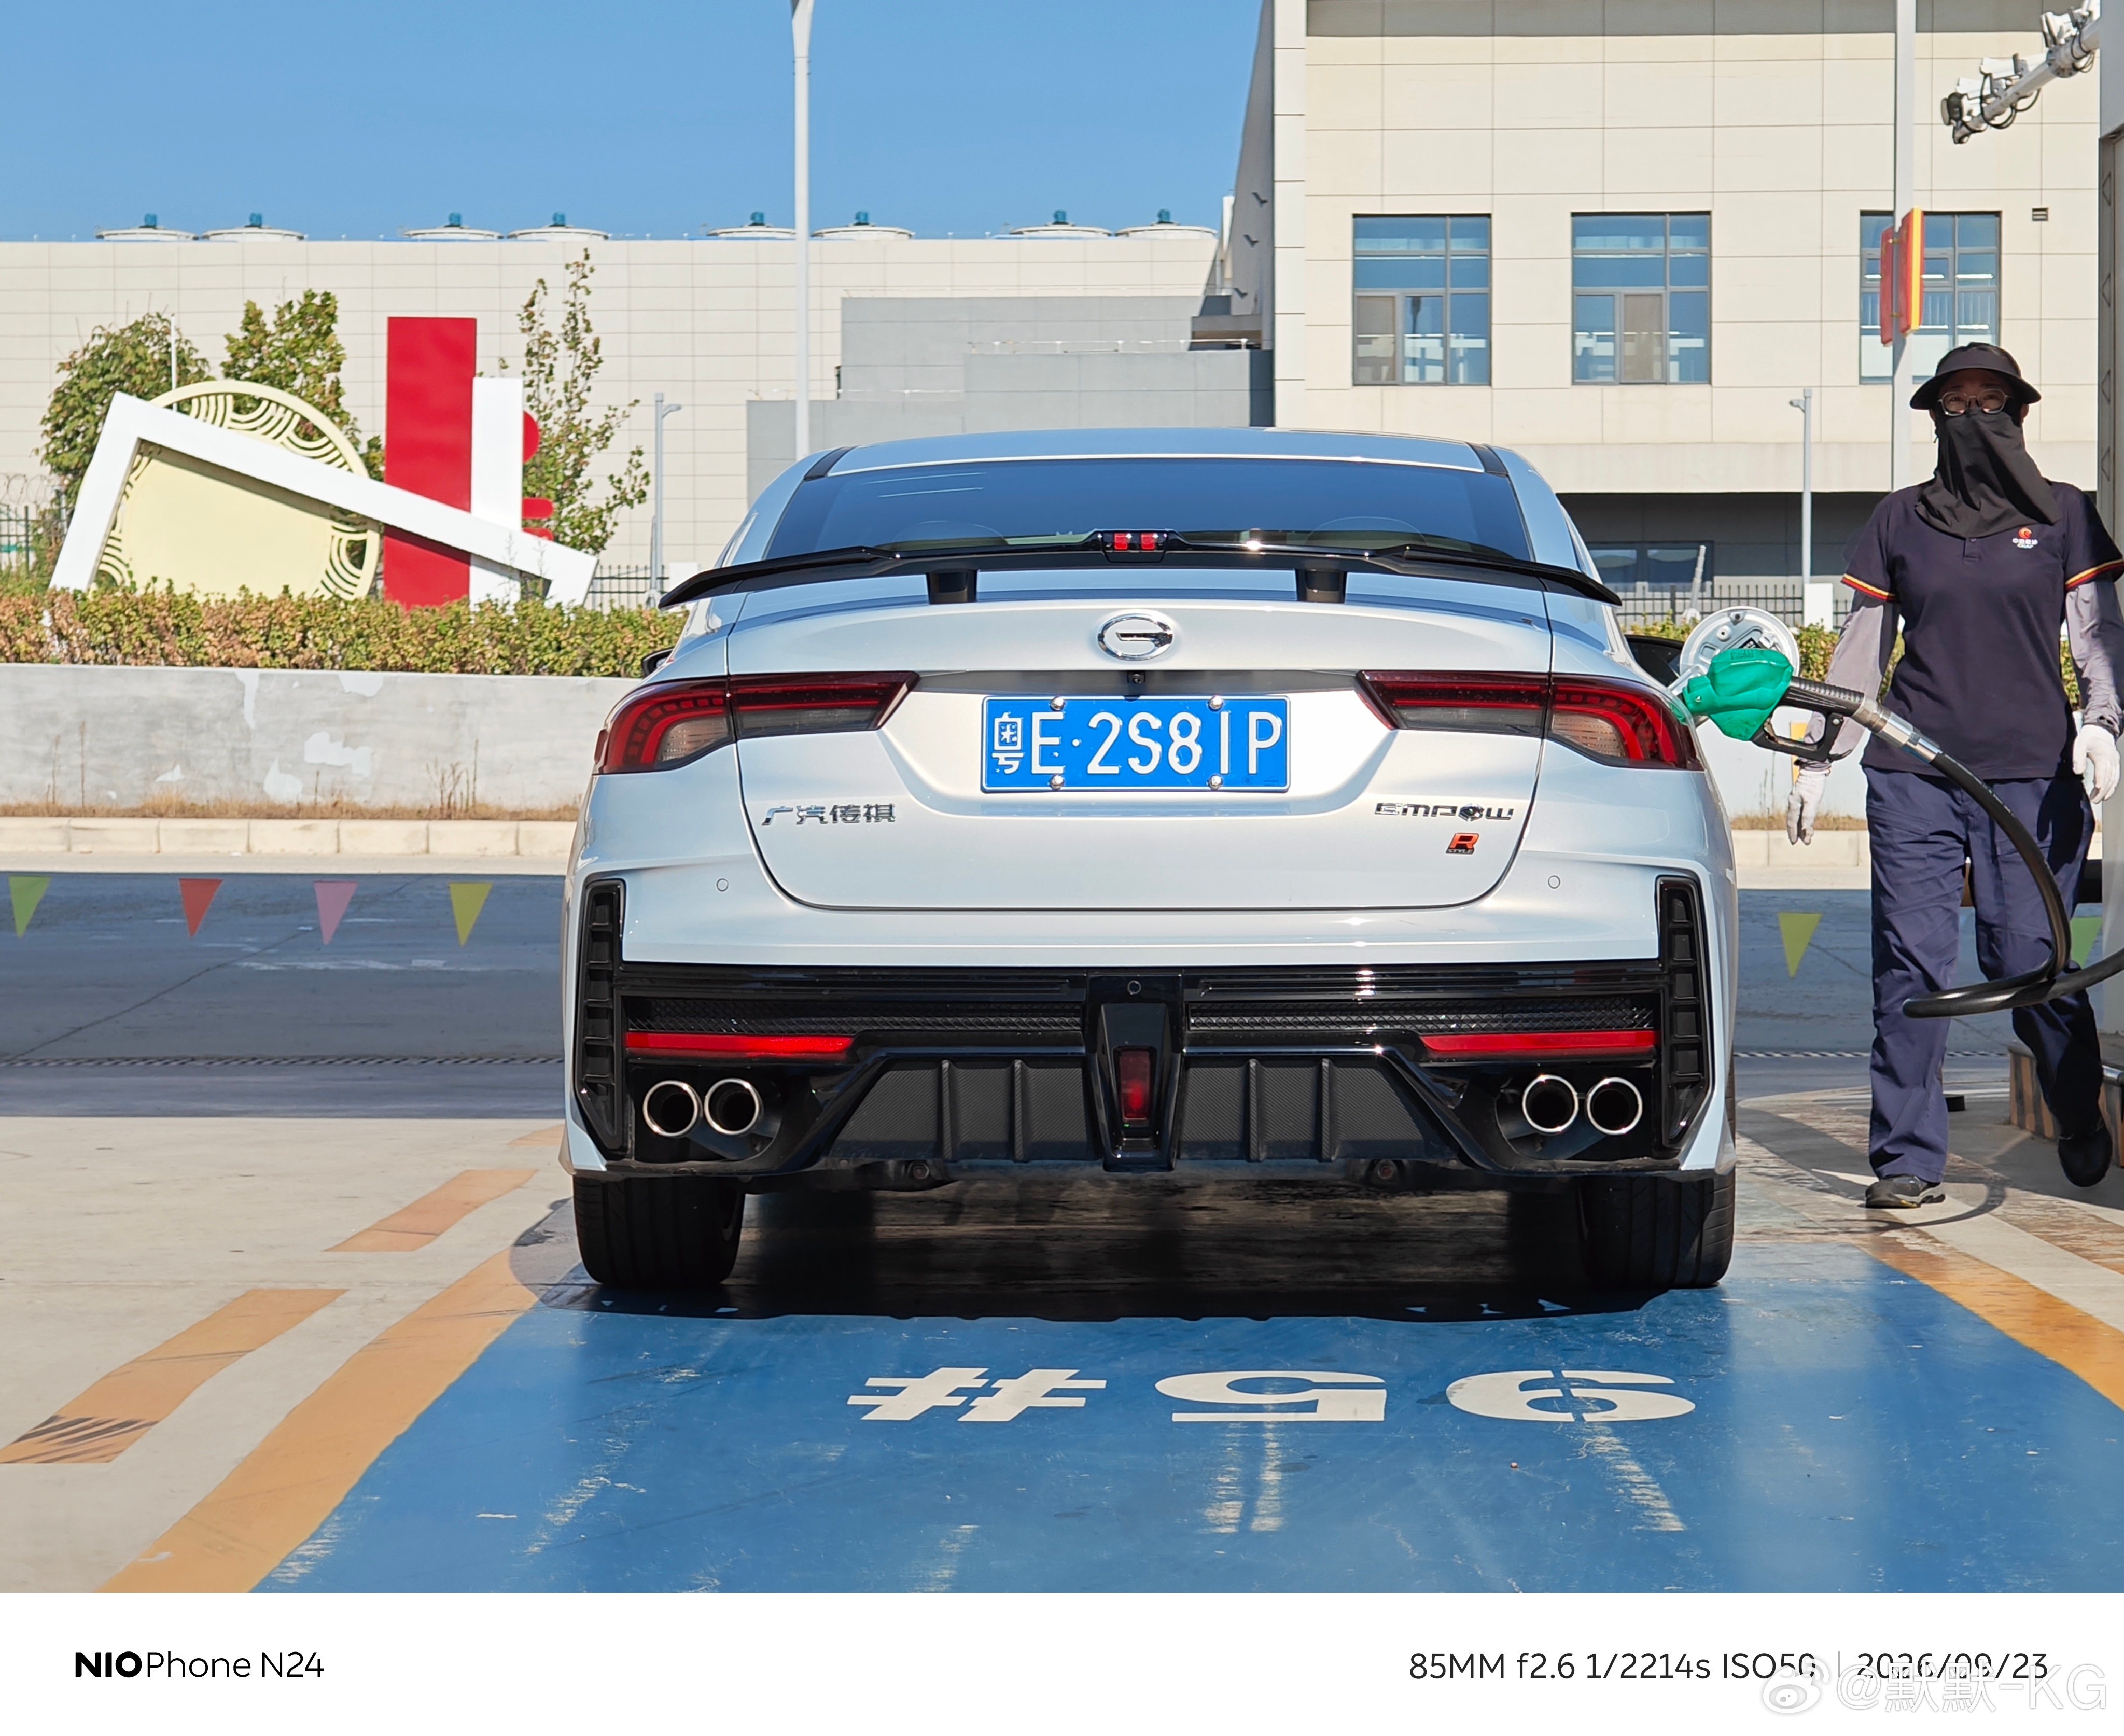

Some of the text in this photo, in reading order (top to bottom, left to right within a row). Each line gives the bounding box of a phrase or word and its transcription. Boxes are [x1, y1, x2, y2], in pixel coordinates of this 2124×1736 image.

[761, 804, 896, 826] 广汽传祺
[1449, 833, 1479, 849] R
